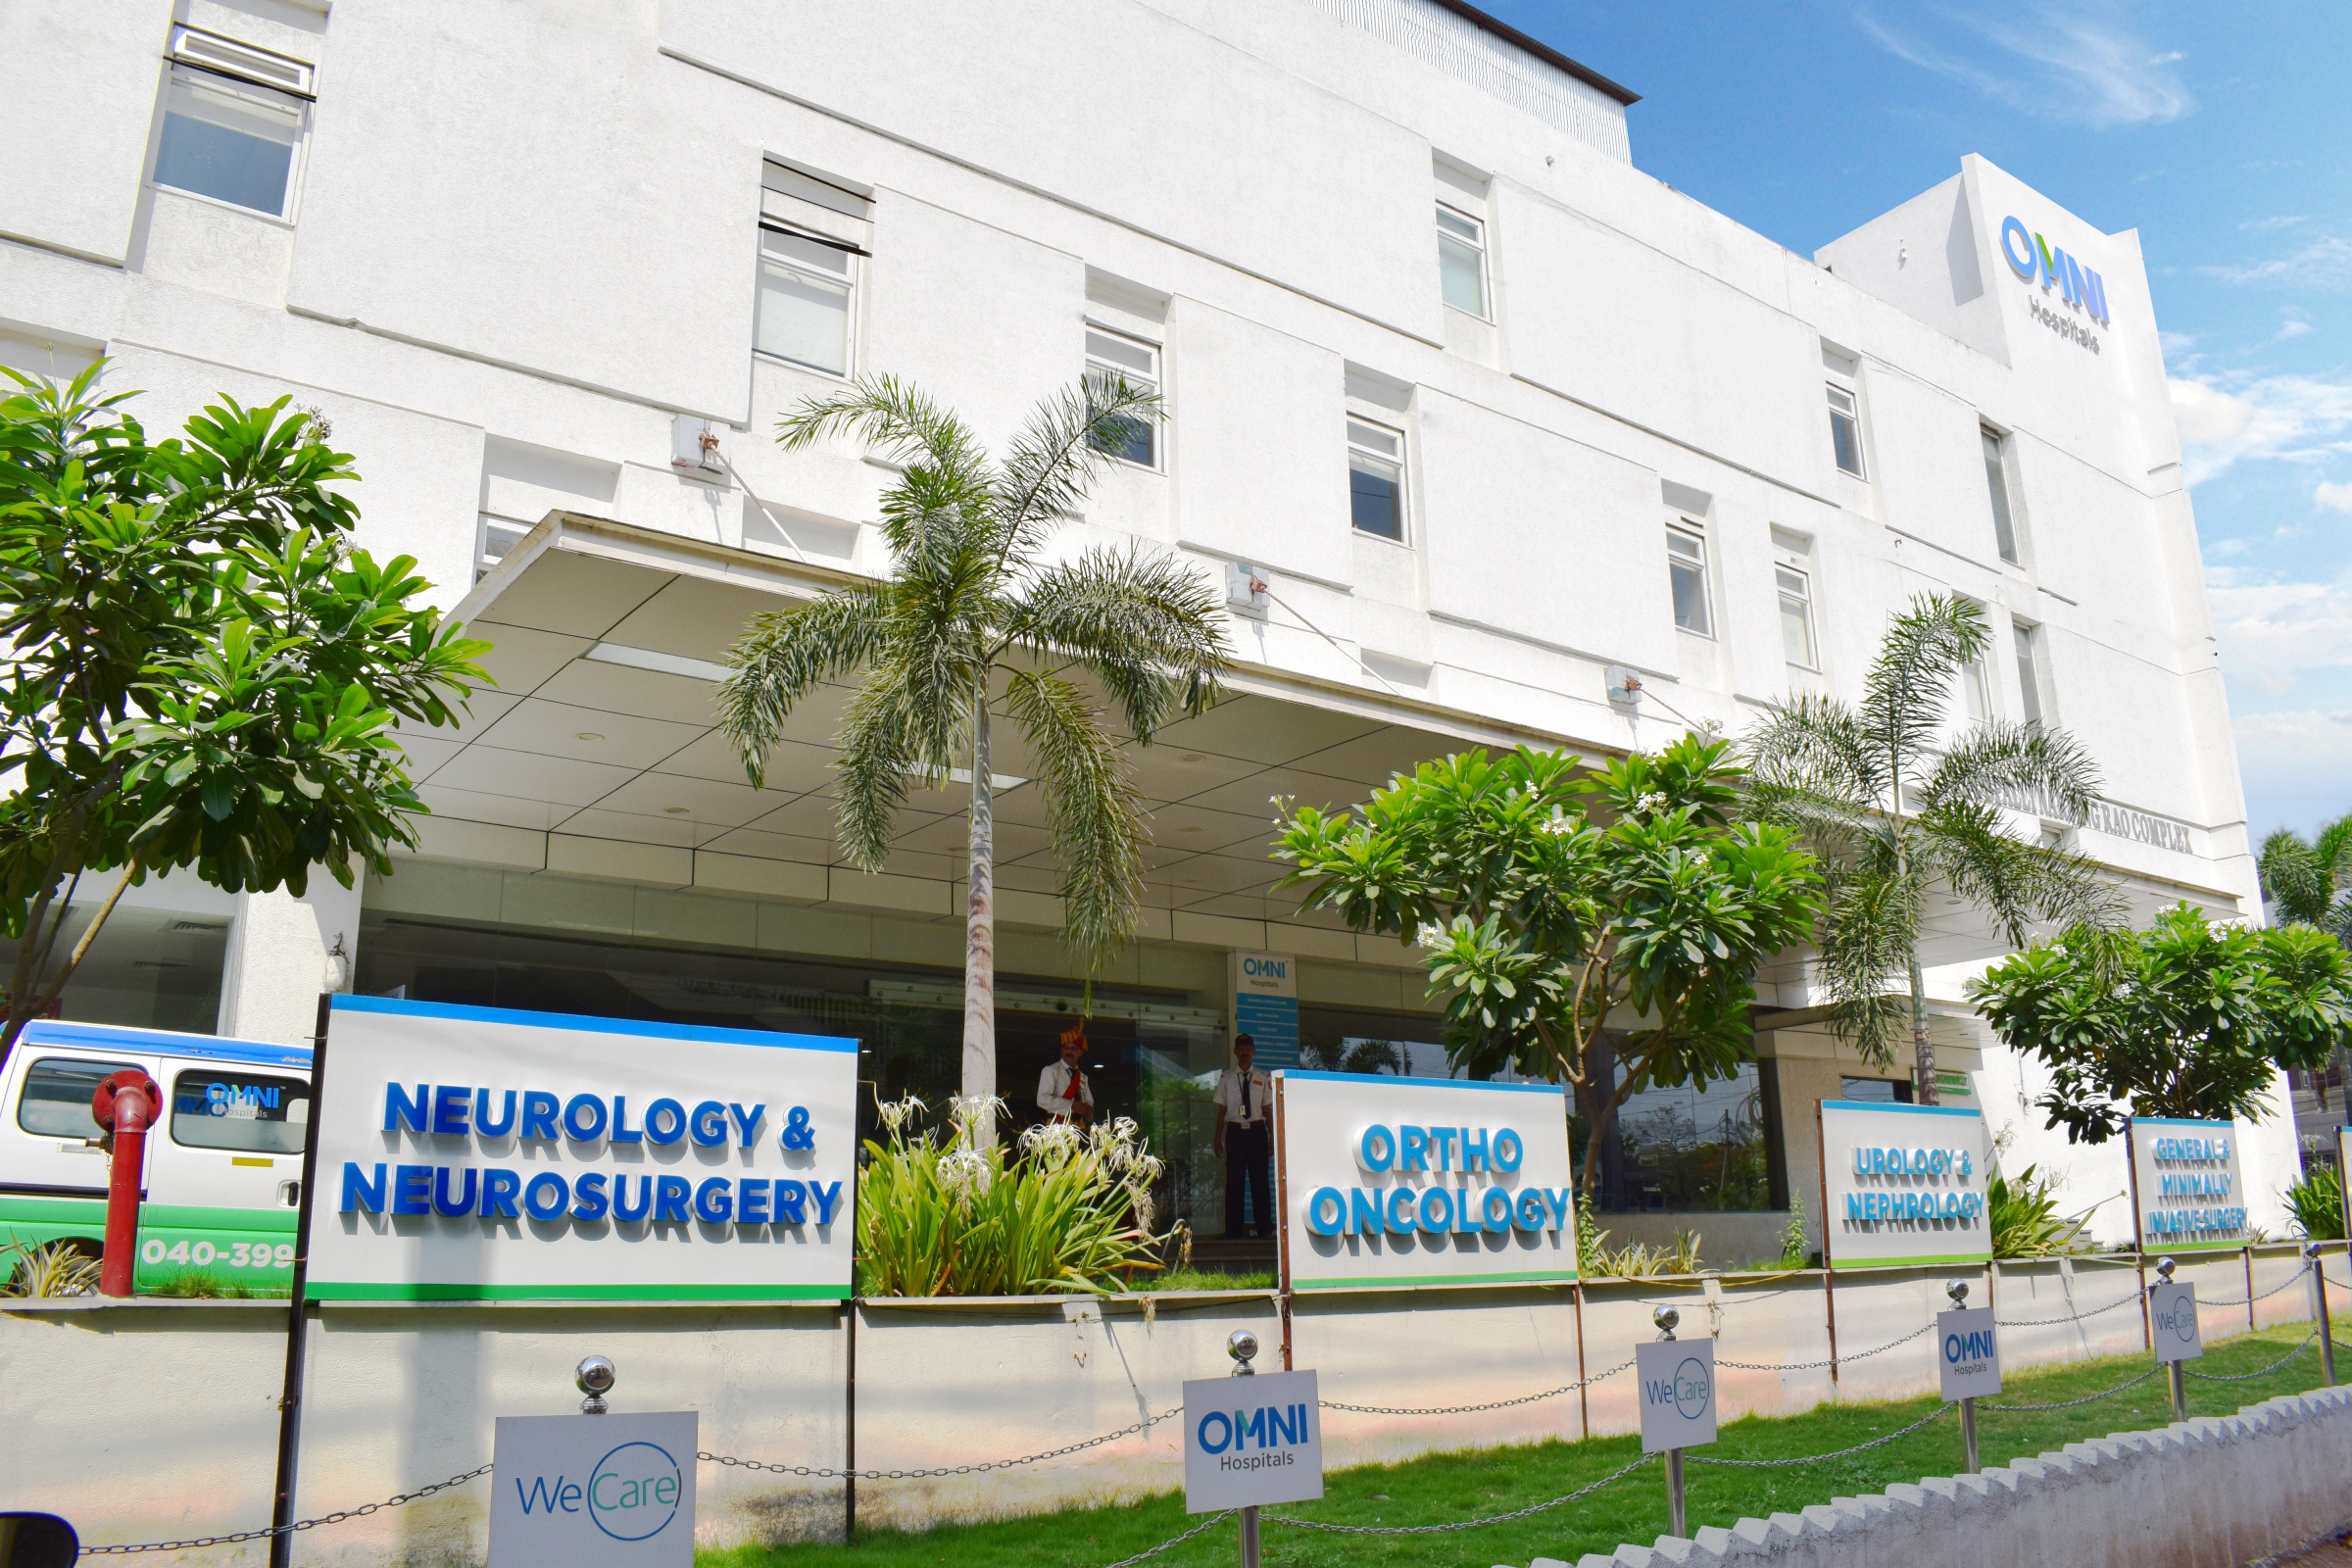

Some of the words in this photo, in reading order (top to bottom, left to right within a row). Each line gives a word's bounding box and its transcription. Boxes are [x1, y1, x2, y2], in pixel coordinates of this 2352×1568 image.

[2001, 215, 2110, 325] OMNI
[2028, 294, 2100, 355] Hospitals
[2101, 803, 2131, 838] RAO
[2132, 811, 2193, 855] COMPLEX
[1243, 957, 1286, 979] OMNI
[205, 1082, 280, 1109] OMNI
[220, 1106, 268, 1119] Hospitals
[381, 1081, 767, 1149] NEUROLOGY
[779, 1104, 817, 1151] &
[1358, 1123, 1524, 1174] ORTHO
[1855, 1147, 1955, 1176] UROLOGY
[1960, 1149, 1973, 1176] &
[2156, 1138, 2220, 1160] GENERAL
[2222, 1138, 2231, 1160] &
[339, 1161, 843, 1225] NEUROSURGERY
[2161, 1173, 2232, 1196] MINIMALLY
[1308, 1185, 1571, 1236] ONCOLOGY
[1846, 1192, 1984, 1220] NEPHROLOGY
[2149, 1208, 2201, 1234] INVASIVE
[2201, 1206, 2248, 1231] SURGERY
[142, 1239, 295, 1268] 040-399
[1944, 1329, 1994, 1364] OMNI
[1954, 1361, 1987, 1376] Hospitals
[1198, 1402, 1308, 1455] OMNI
[1220, 1450, 1295, 1472] Hospitals
